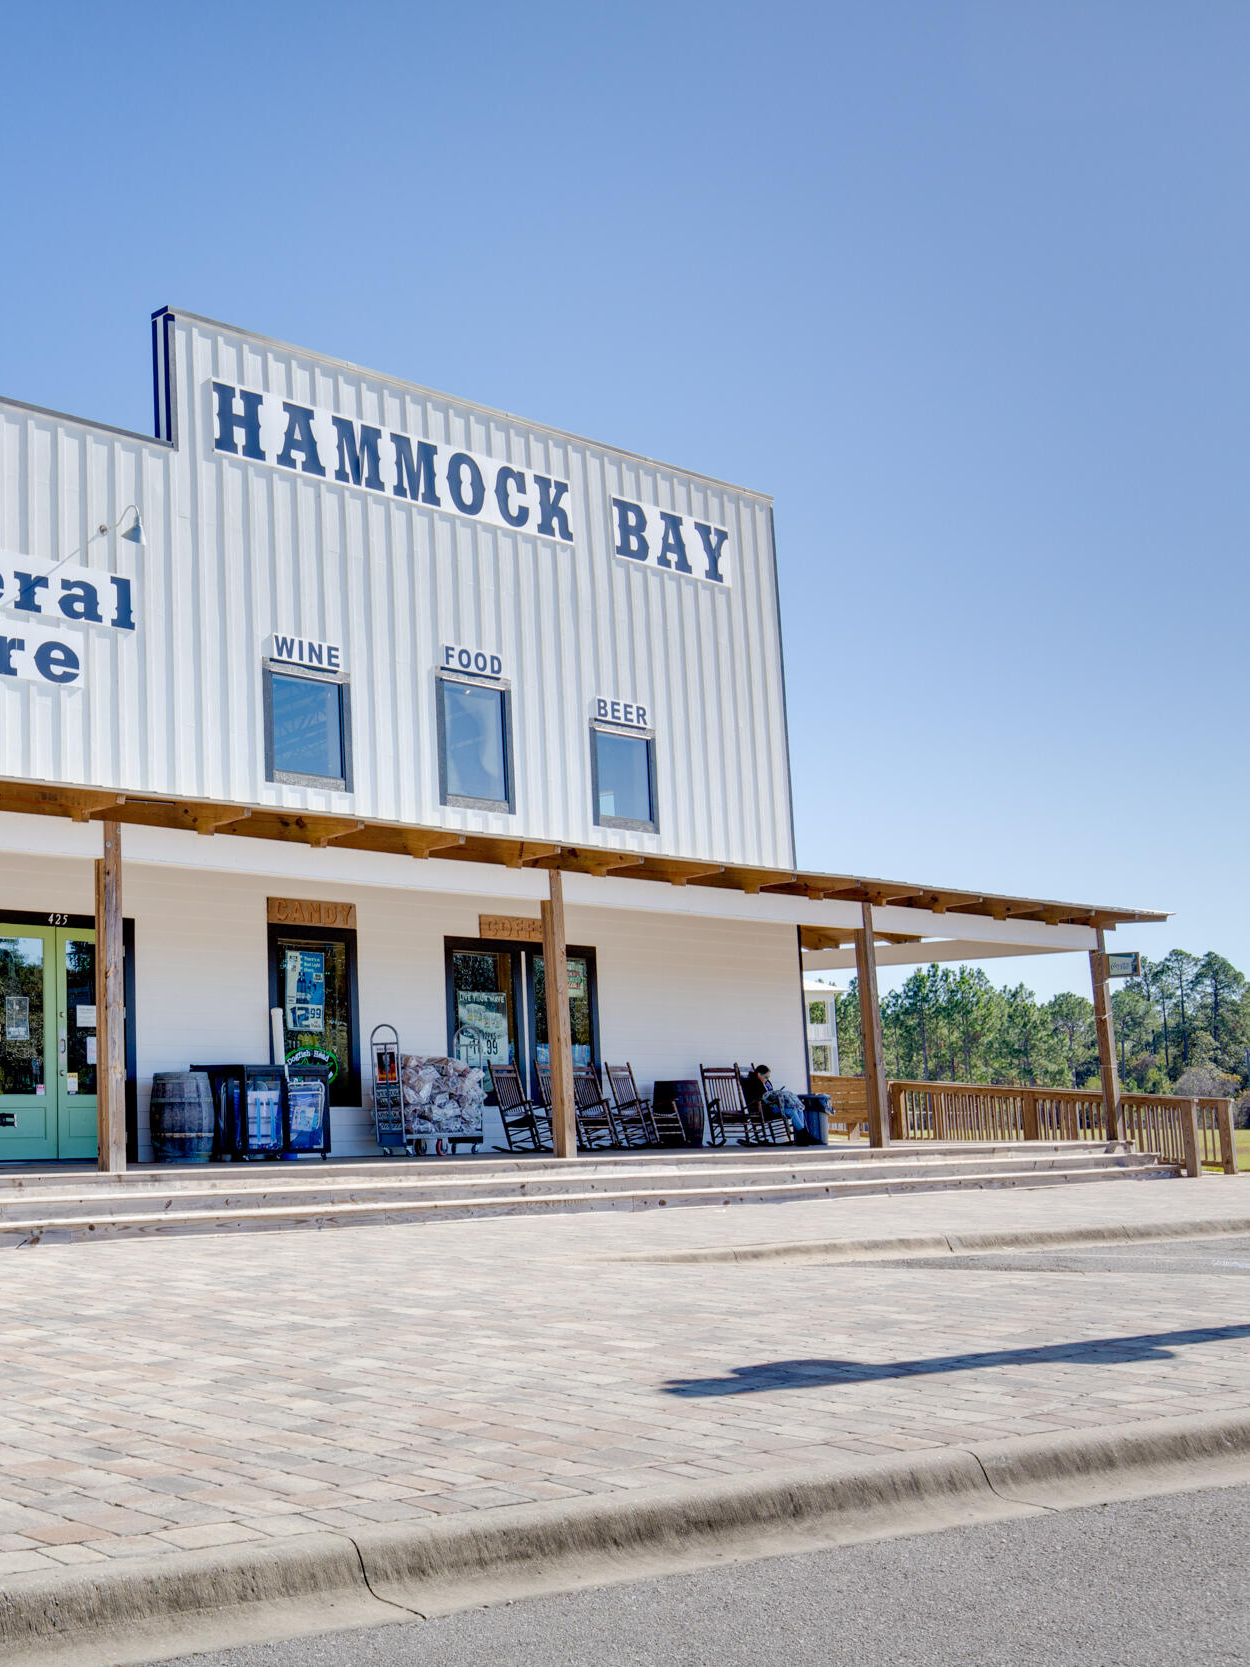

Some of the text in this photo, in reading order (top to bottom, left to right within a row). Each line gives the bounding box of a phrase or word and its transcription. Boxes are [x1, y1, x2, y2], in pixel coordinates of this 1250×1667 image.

[212, 381, 728, 584] HAMMOCK BAY
[273, 634, 340, 669] WINE
[444, 645, 502, 675] FOOD
[597, 699, 648, 726] BEER
[48, 913, 68, 925] 425
[275, 899, 352, 925] CANDY
[487, 918, 543, 938] COFFE
[290, 1006, 311, 1028] 12
[310, 1007, 322, 1019] 99
[287, 1050, 330, 1065] Dogfish Head
